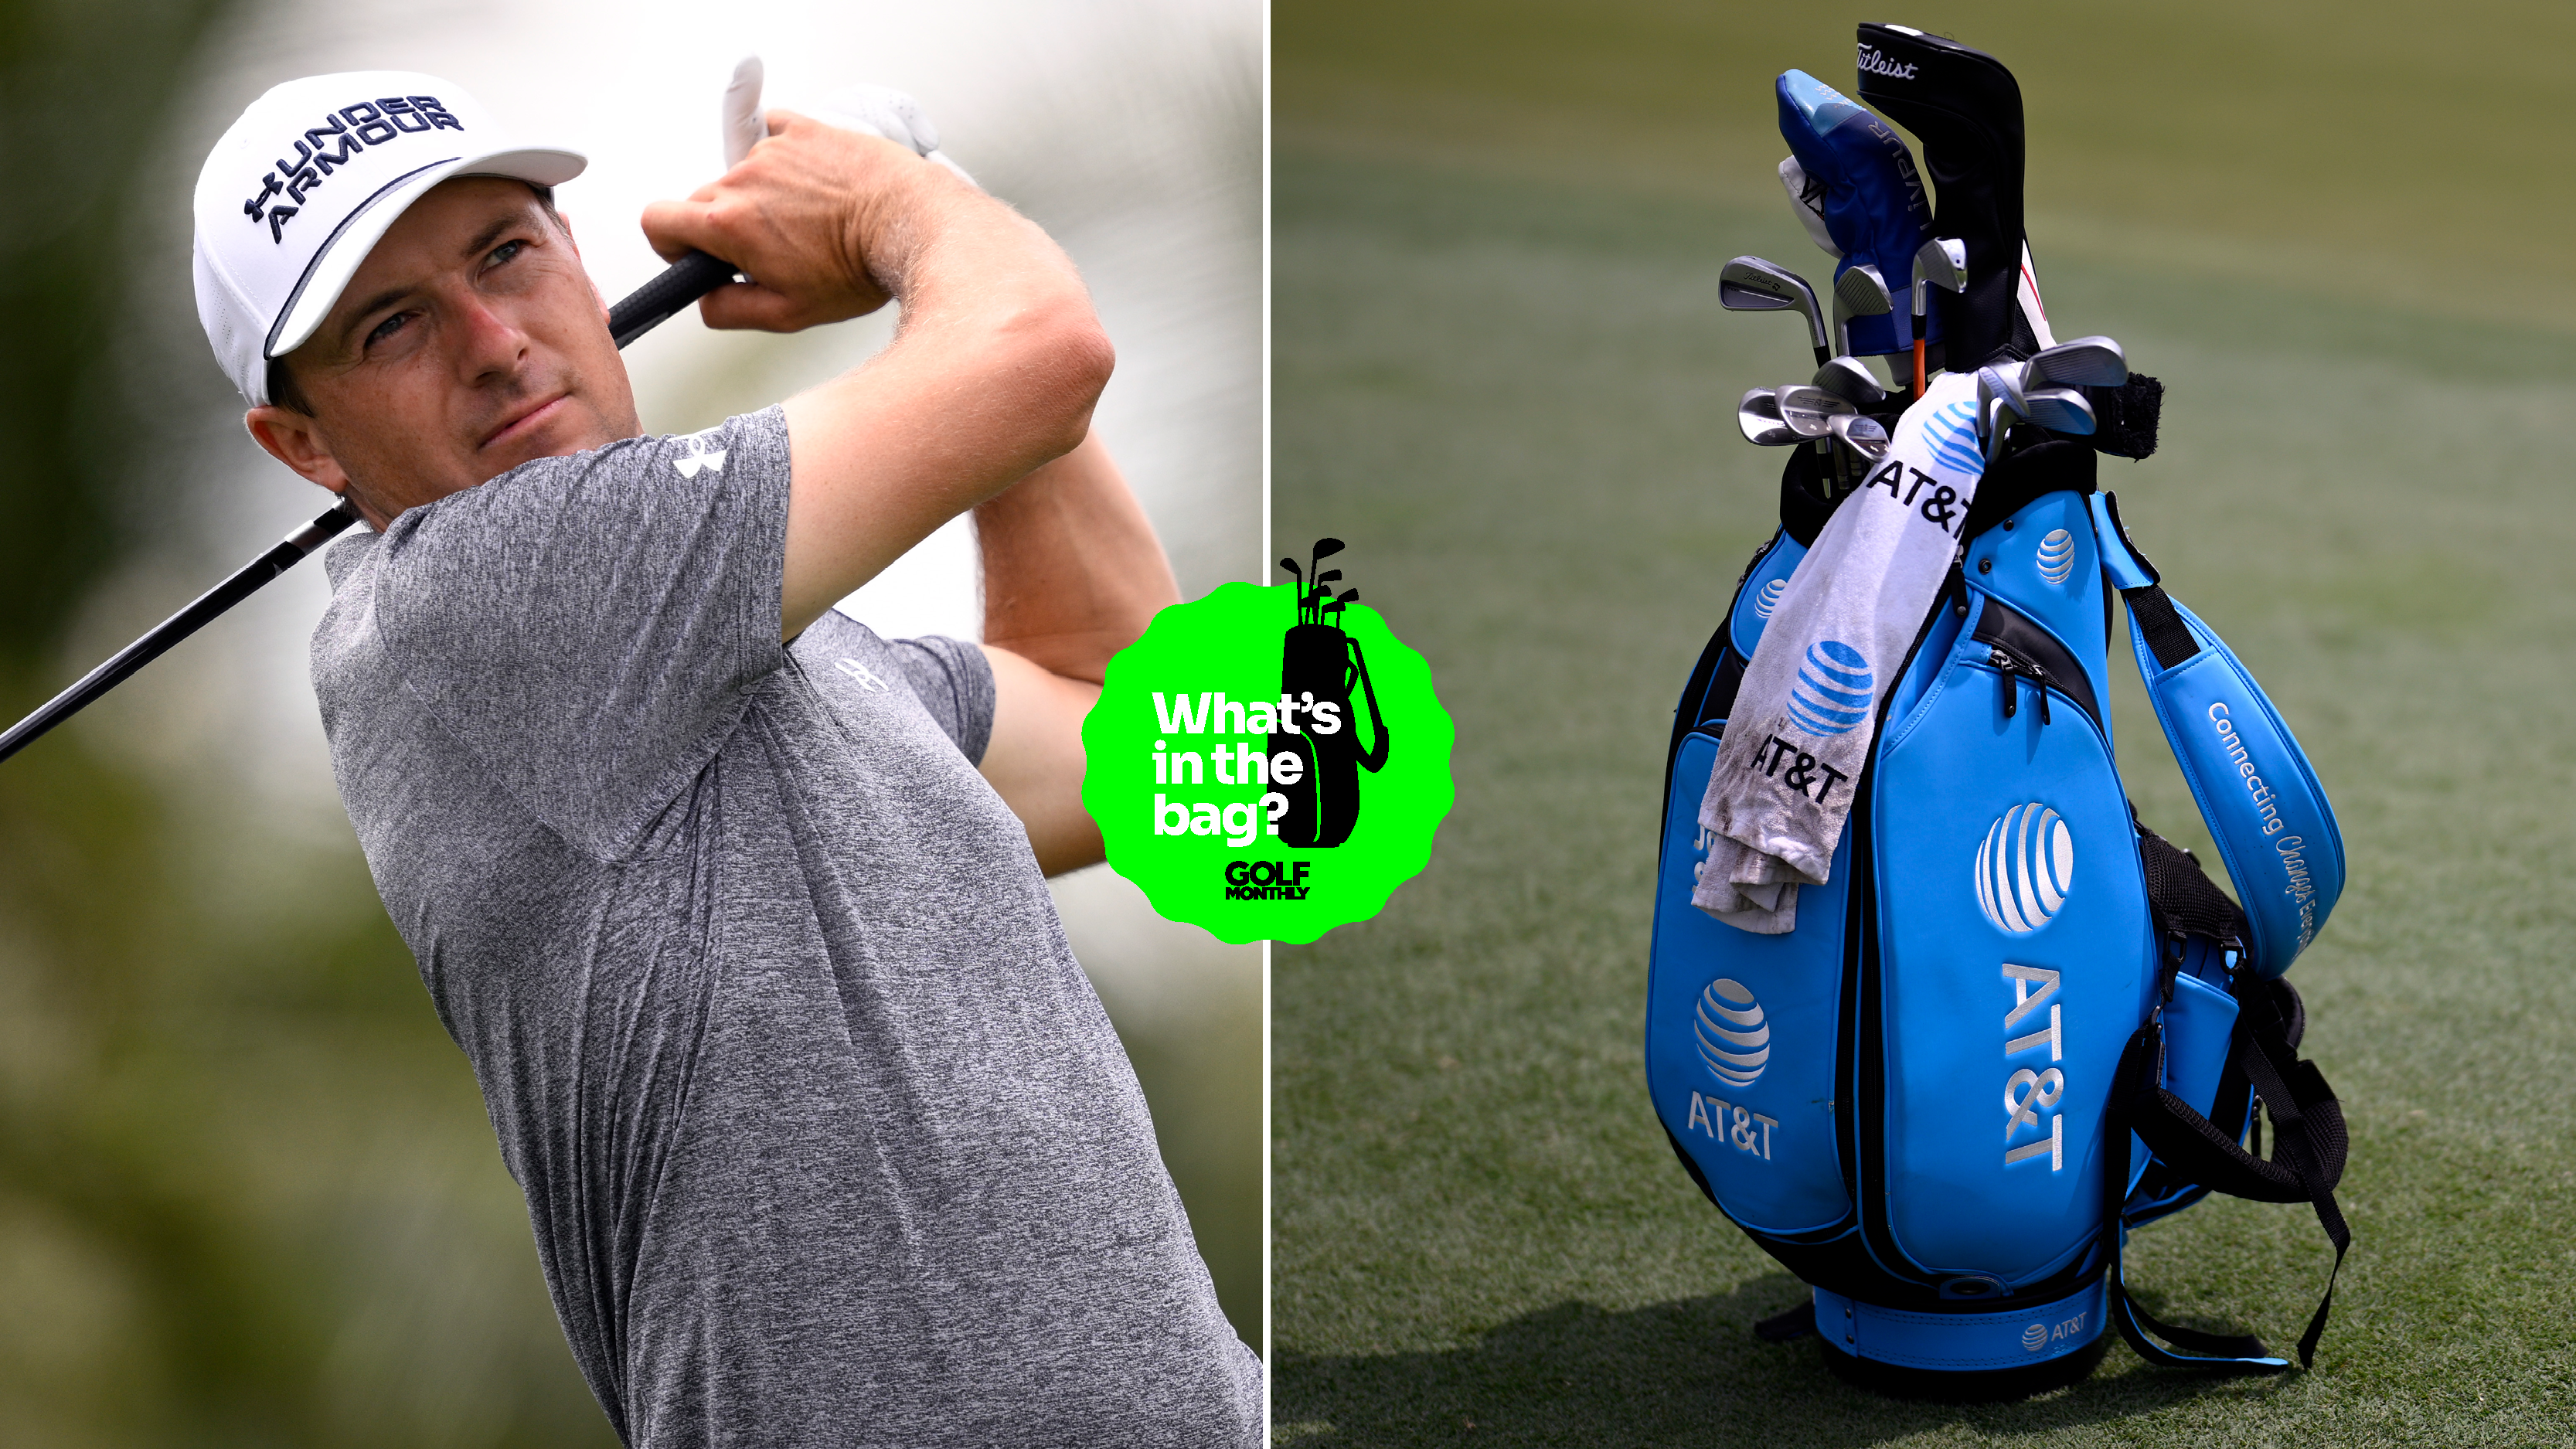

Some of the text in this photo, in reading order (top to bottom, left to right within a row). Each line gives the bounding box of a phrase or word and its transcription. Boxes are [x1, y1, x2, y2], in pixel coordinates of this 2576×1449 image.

[276, 95, 446, 178] UNDER
[268, 111, 464, 244] ARMOUR
[1744, 272, 1773, 286] Titleist
[1751, 733, 1848, 805] AT&T
[2208, 702, 2285, 836] Connecting
[2002, 963, 2064, 1172] AT&T
[1688, 1090, 1778, 1161] AT&T
[2051, 1311, 2088, 1342] AT&T
